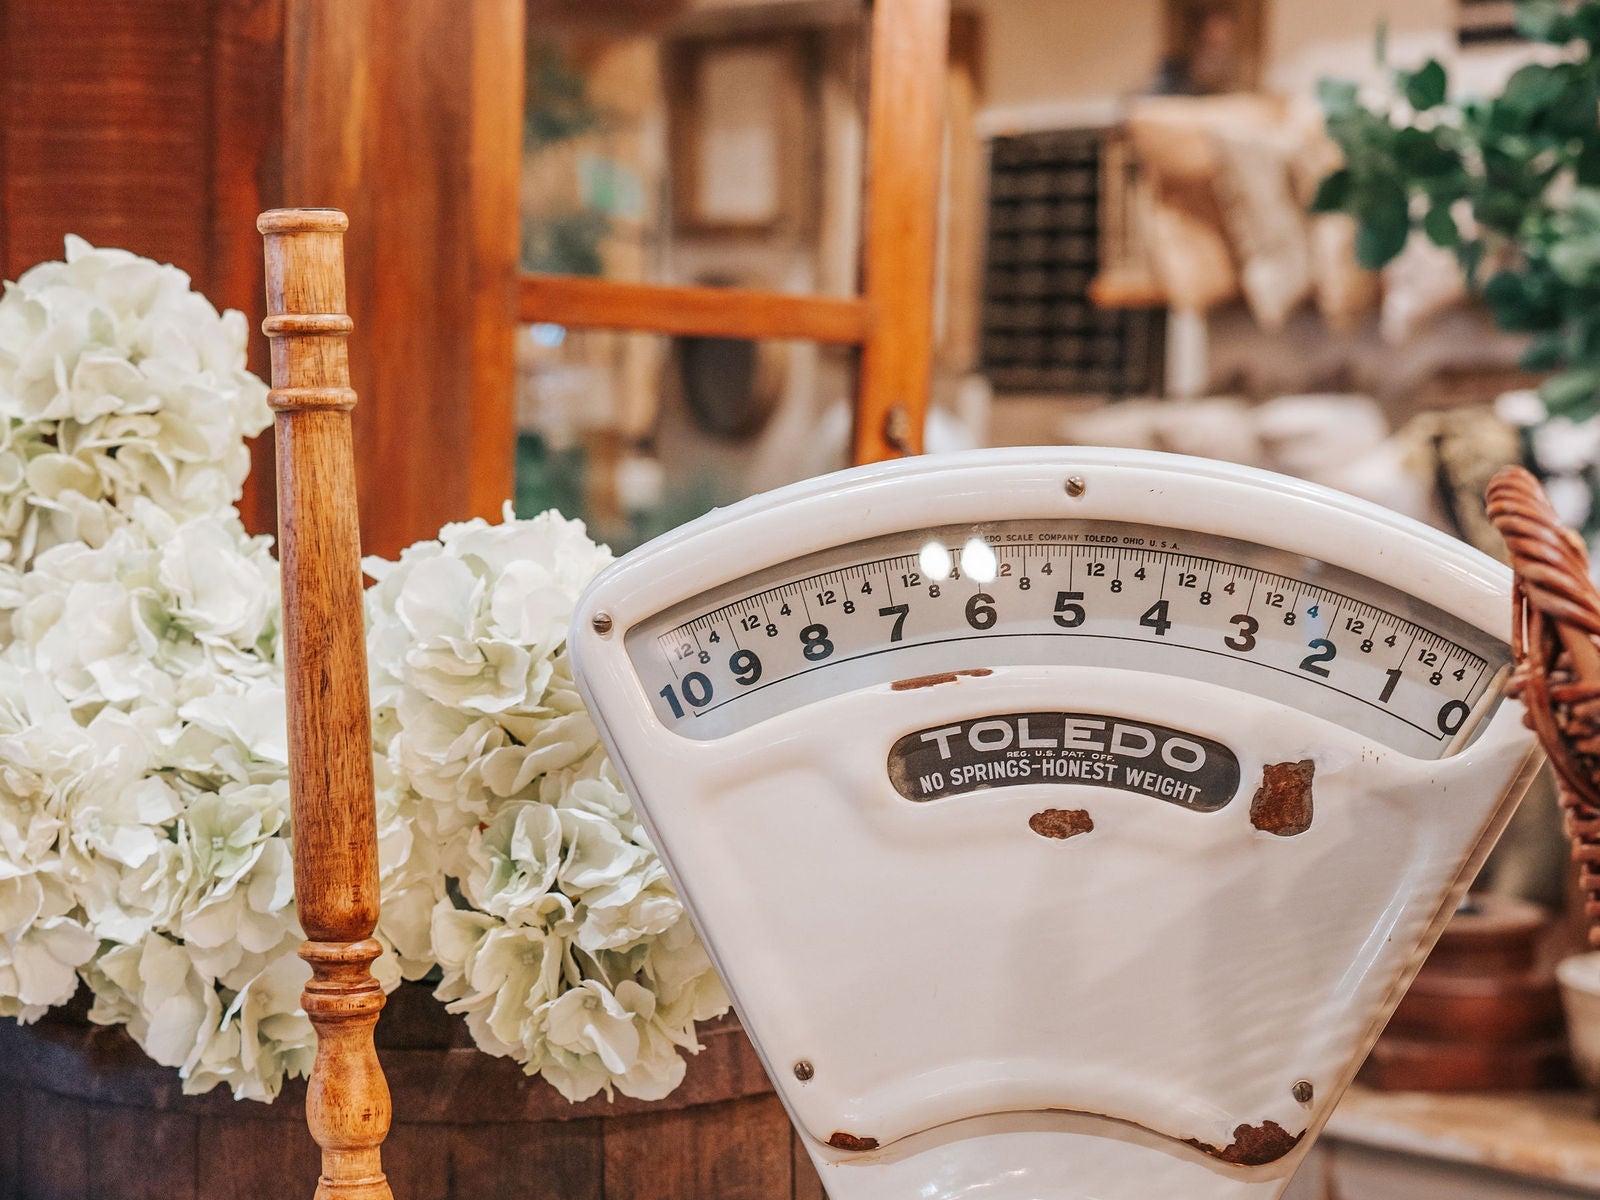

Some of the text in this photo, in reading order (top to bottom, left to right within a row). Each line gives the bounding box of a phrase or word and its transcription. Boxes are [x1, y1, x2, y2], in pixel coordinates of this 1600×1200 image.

[1006, 534, 1034, 542] SCALE
[1038, 534, 1079, 542] COMPANY
[1085, 535, 1118, 543] TOLEDO
[1123, 537, 1144, 546] OHIO
[674, 642, 694, 660] 12
[708, 630, 720, 644] 4
[740, 615, 760, 631] 12
[780, 604, 792, 616] 4
[816, 591, 837, 606] 12
[861, 582, 872, 594] 4
[902, 573, 921, 587] 12
[949, 567, 960, 580] 4
[1041, 563, 1052, 576] 4
[1086, 563, 1105, 576] 12
[1134, 568, 1146, 580] 4
[1178, 573, 1197, 588] 12
[1224, 582, 1235, 595] 4
[1265, 592, 1284, 608] 12
[1306, 605, 1318, 618] 4
[1346, 618, 1364, 634] 12
[1385, 635, 1396, 648] 4
[1418, 650, 1438, 667] 12
[1452, 667, 1464, 681] 4
[698, 577, 1442, 685] 8 8 8 8 8 8 8 8 8 8
[659, 592, 1471, 736] 10 9 8 7 6 5 4 3 2 1 0
[920, 718, 1206, 772] TOLEDO
[1006, 749, 1115, 762] REG. U.S. PAT. OFF.
[920, 771, 945, 794] NO
[1125, 768, 1202, 804] WEIGHT
